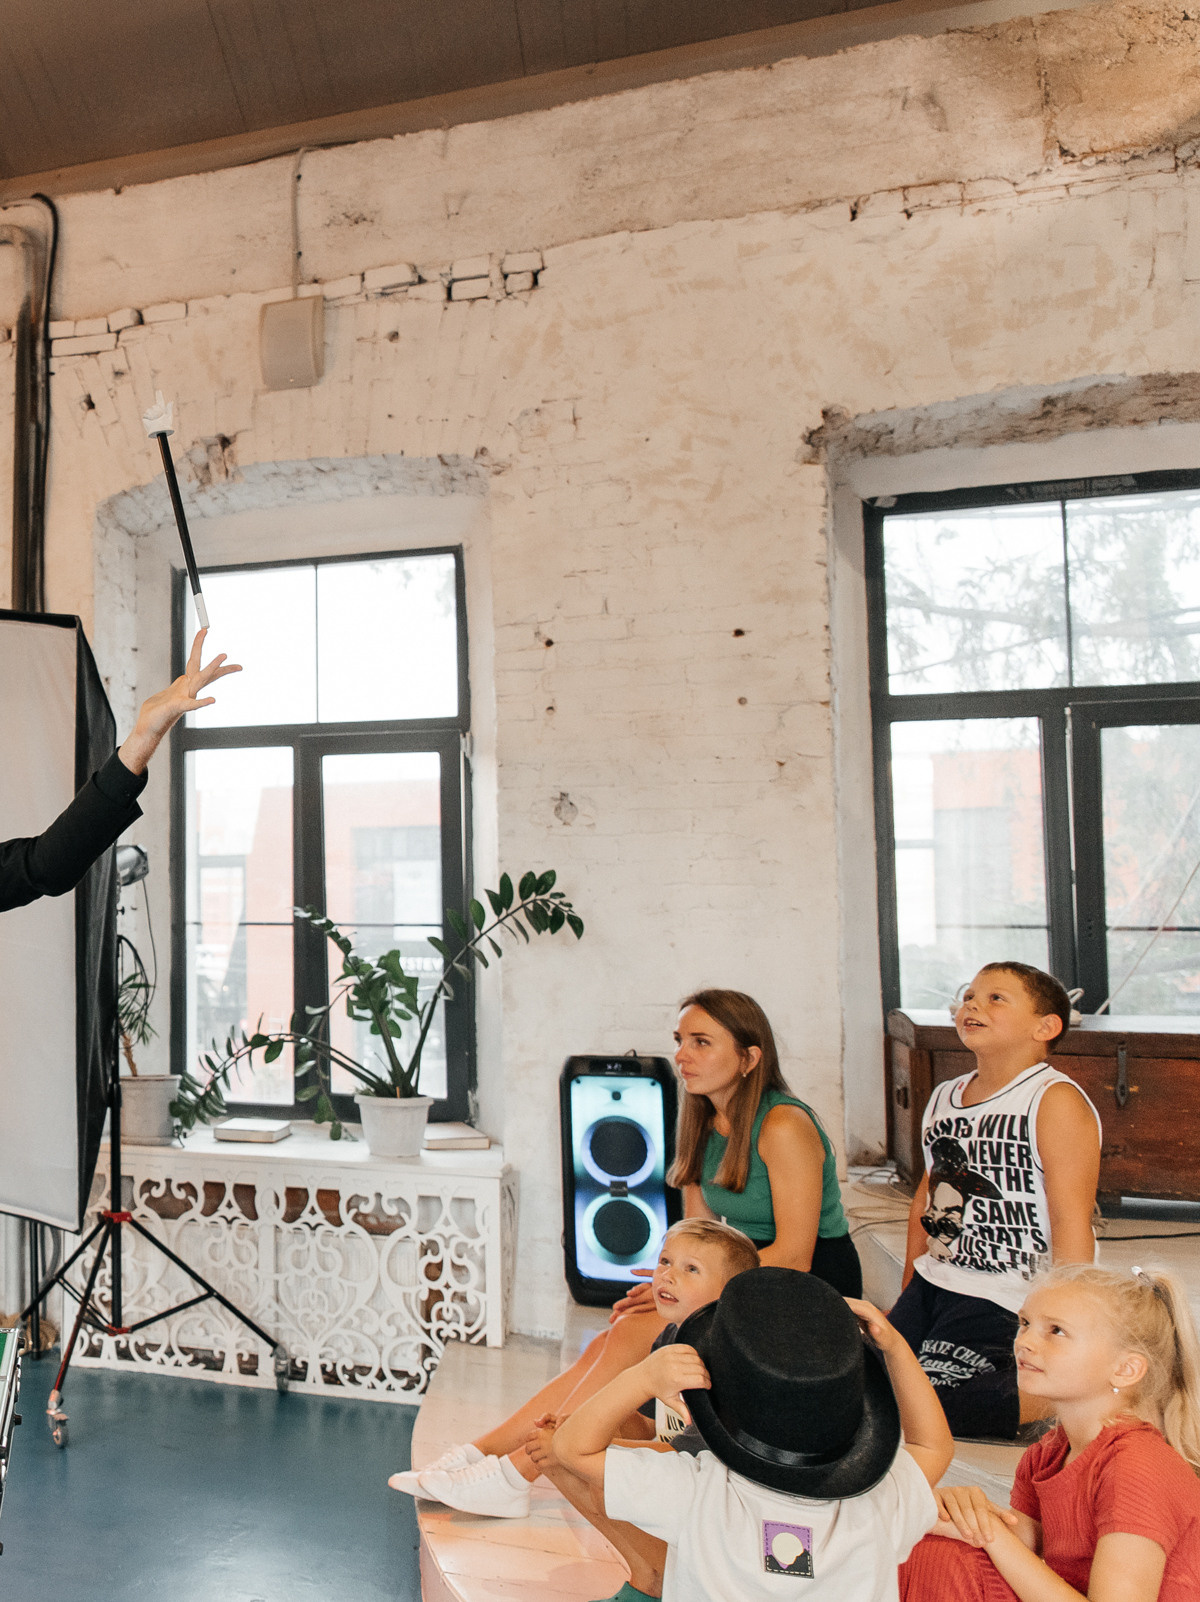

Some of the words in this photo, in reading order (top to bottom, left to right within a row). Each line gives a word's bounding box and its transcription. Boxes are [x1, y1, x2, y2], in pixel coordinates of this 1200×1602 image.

[967, 1140, 1033, 1170] NEVER
[989, 1165, 1036, 1195] THE
[972, 1199, 1040, 1228] SAME
